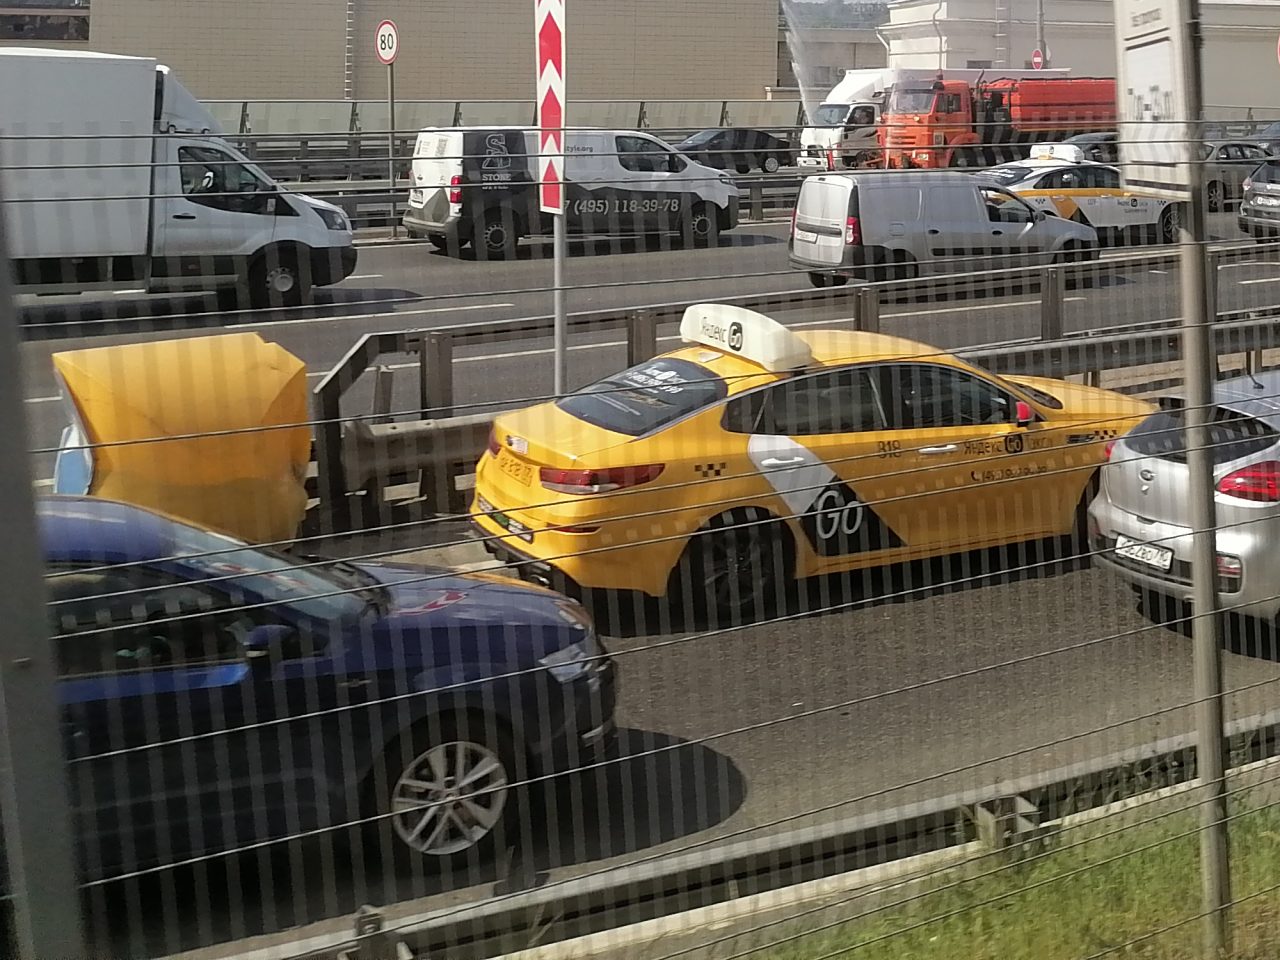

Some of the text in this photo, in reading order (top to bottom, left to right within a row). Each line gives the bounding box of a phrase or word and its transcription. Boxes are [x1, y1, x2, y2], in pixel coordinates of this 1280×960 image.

[380, 33, 394, 50] 80
[574, 199, 609, 215] (495)
[613, 198, 679, 213] 118-39-78
[963, 438, 1003, 456] Яндекс
[816, 490, 863, 539] Go
